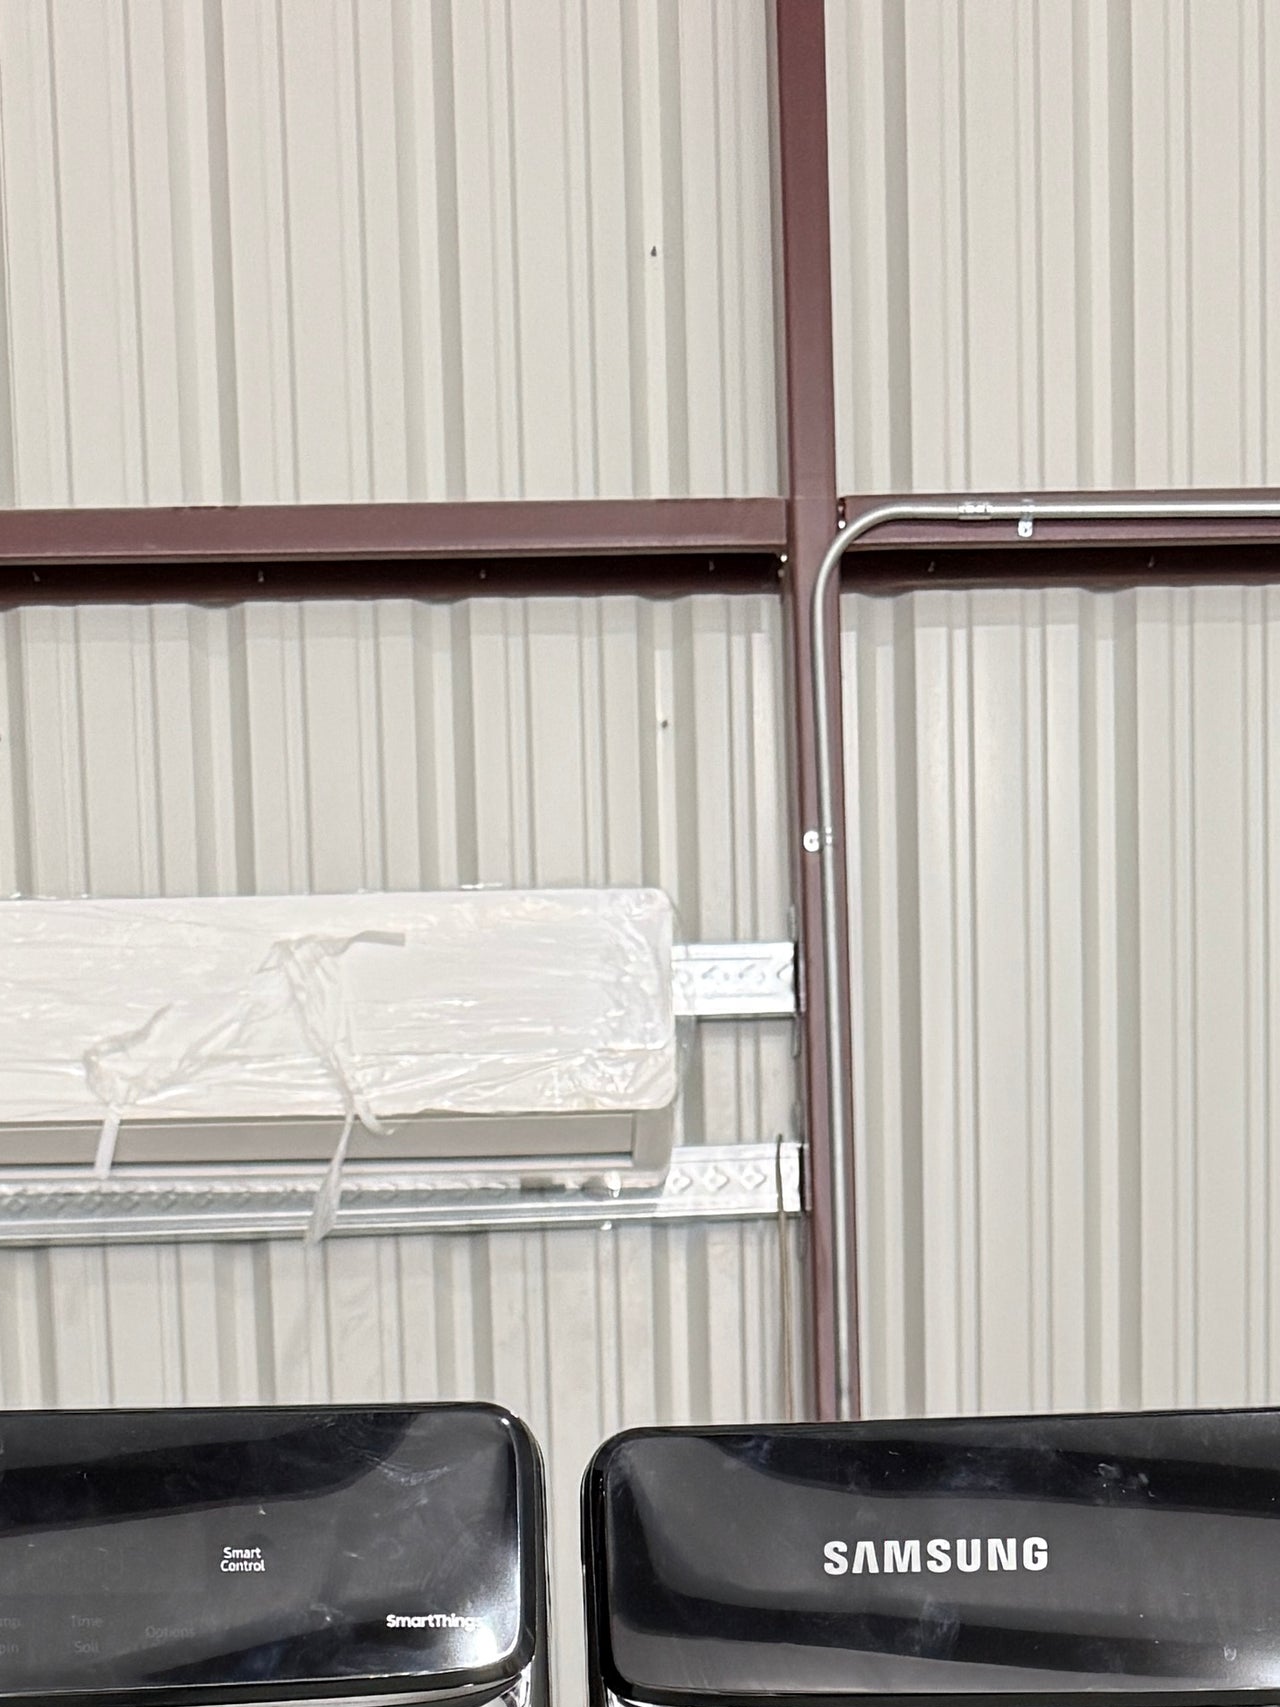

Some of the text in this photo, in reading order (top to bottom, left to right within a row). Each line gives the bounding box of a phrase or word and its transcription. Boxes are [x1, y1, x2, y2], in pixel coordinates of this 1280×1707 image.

[223, 1547, 261, 1559] Smart
[823, 1536, 1048, 1575] SAMSUNG
[220, 1560, 266, 1573] Control
